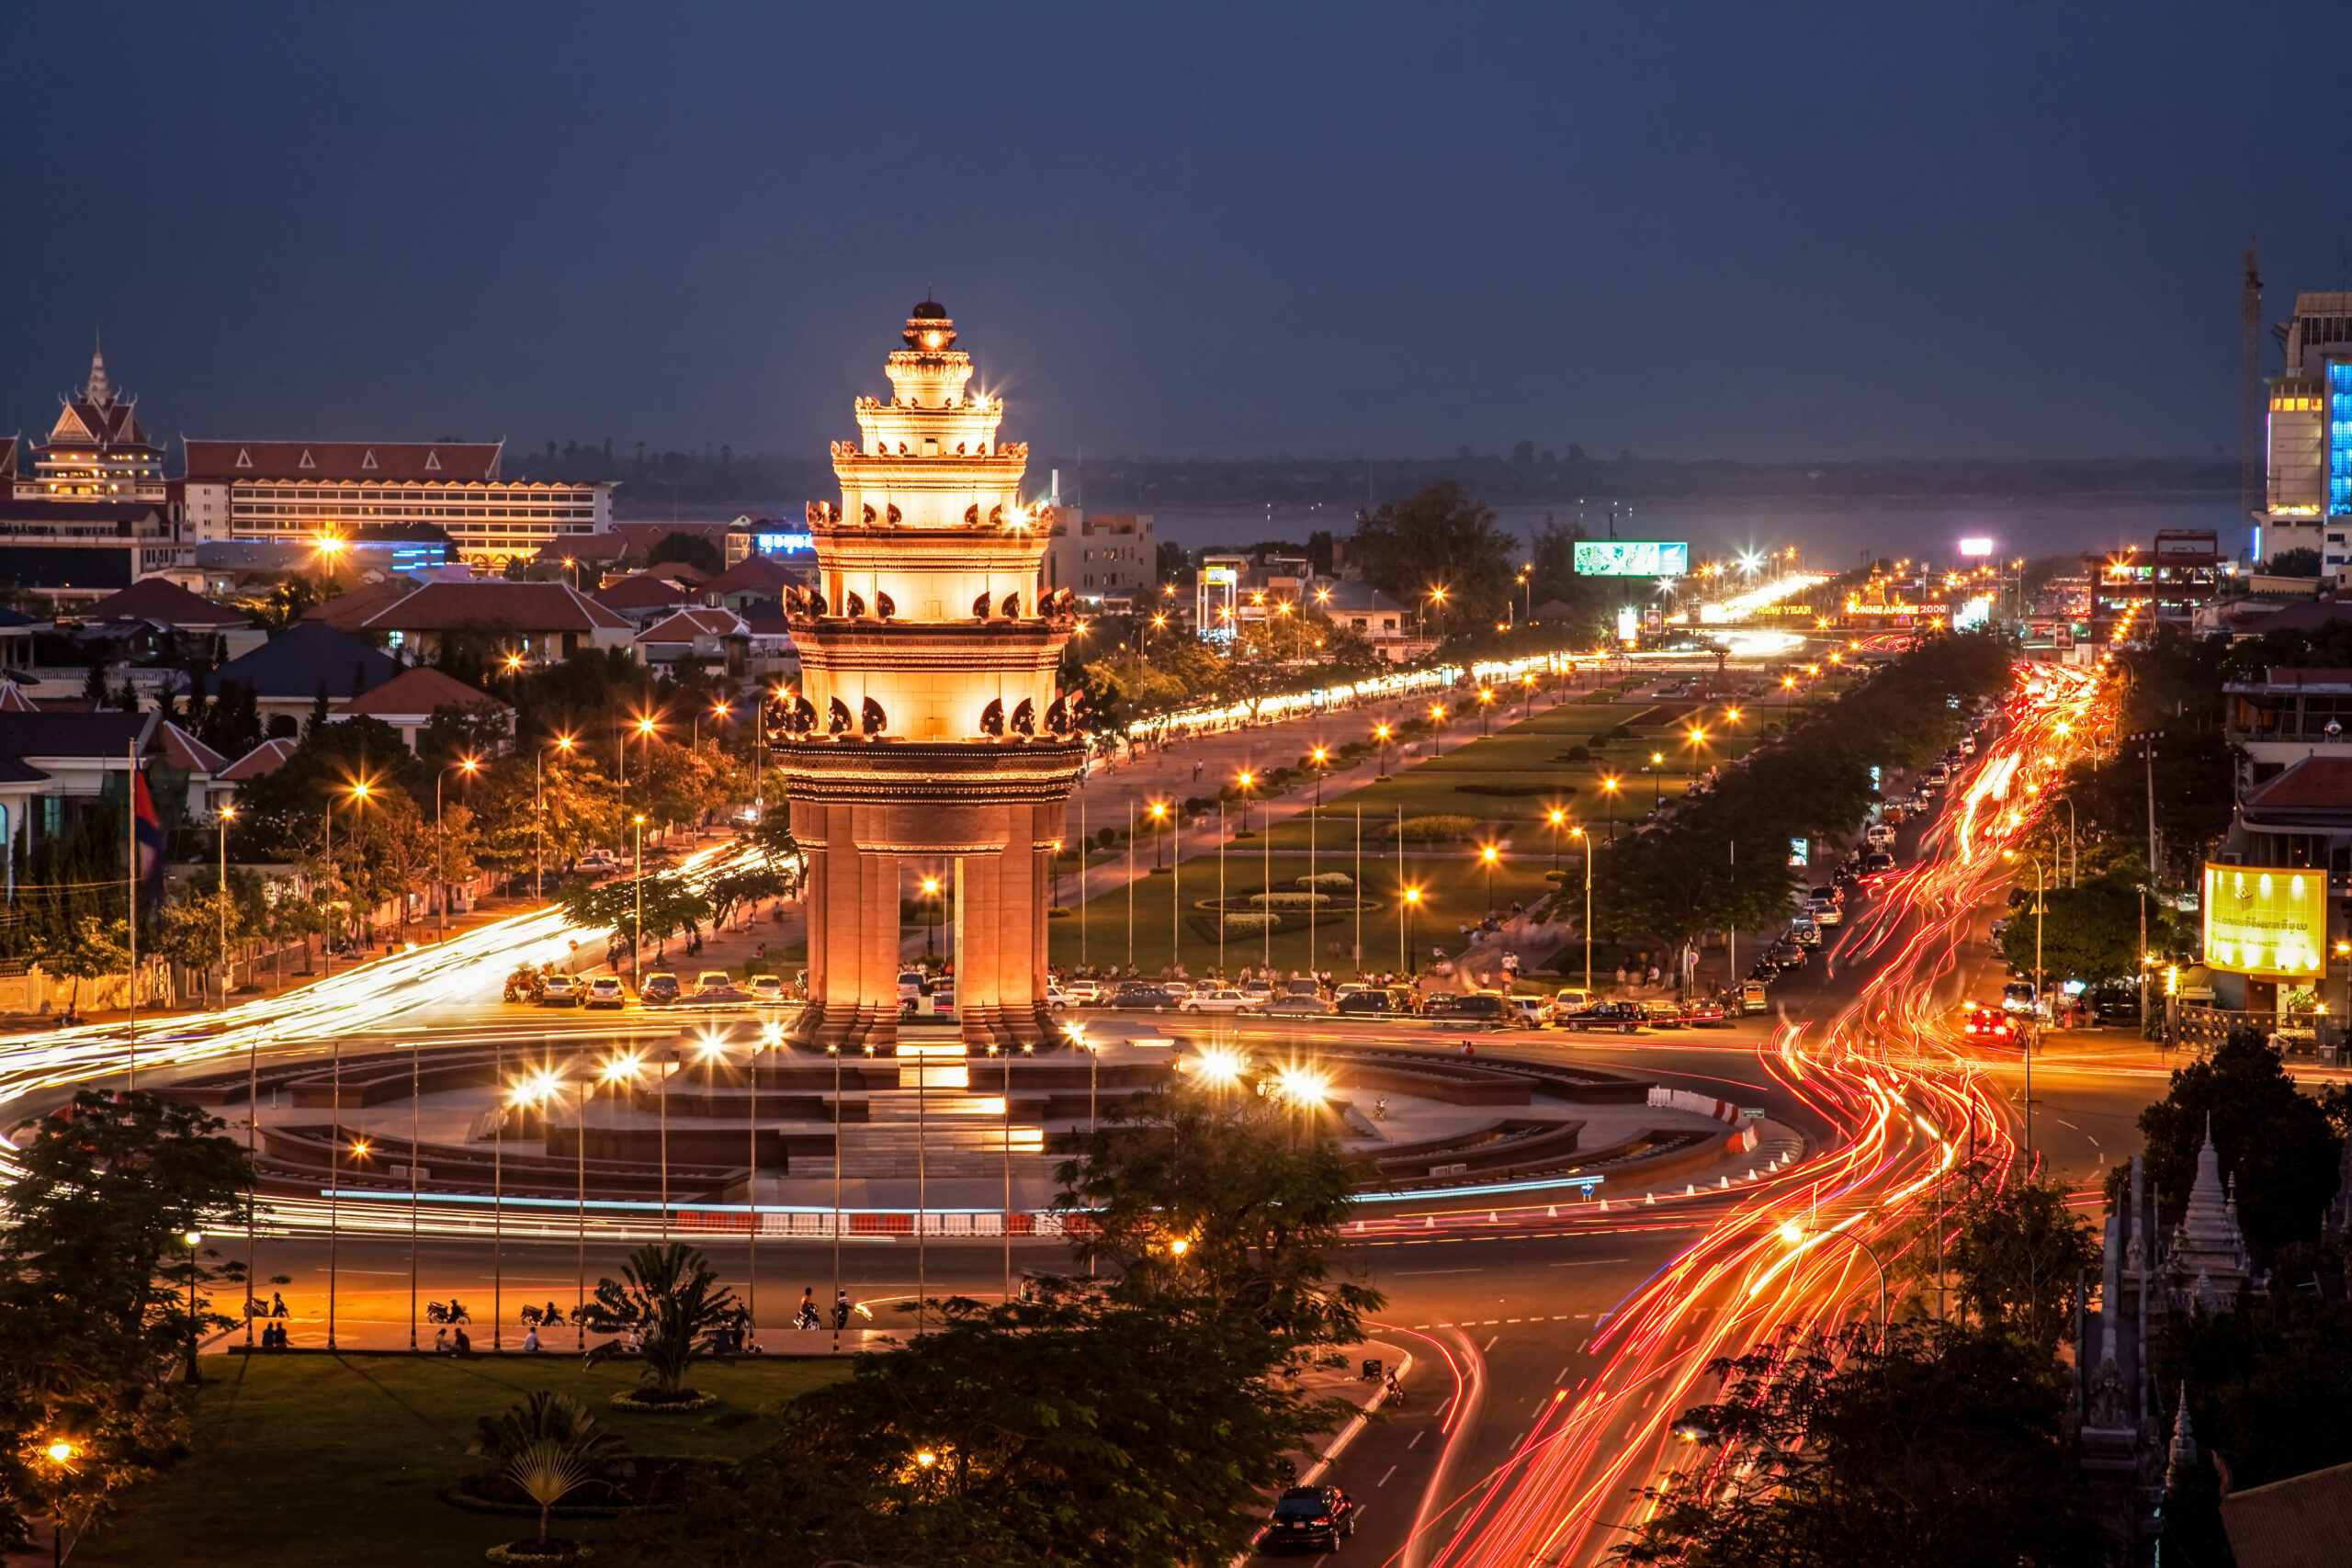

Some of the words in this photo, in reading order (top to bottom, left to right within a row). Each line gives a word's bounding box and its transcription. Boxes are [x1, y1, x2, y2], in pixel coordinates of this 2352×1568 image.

[1757, 604, 1782, 615] NEW
[1784, 604, 1813, 615] YEAR
[1919, 604, 1947, 615] 2009
